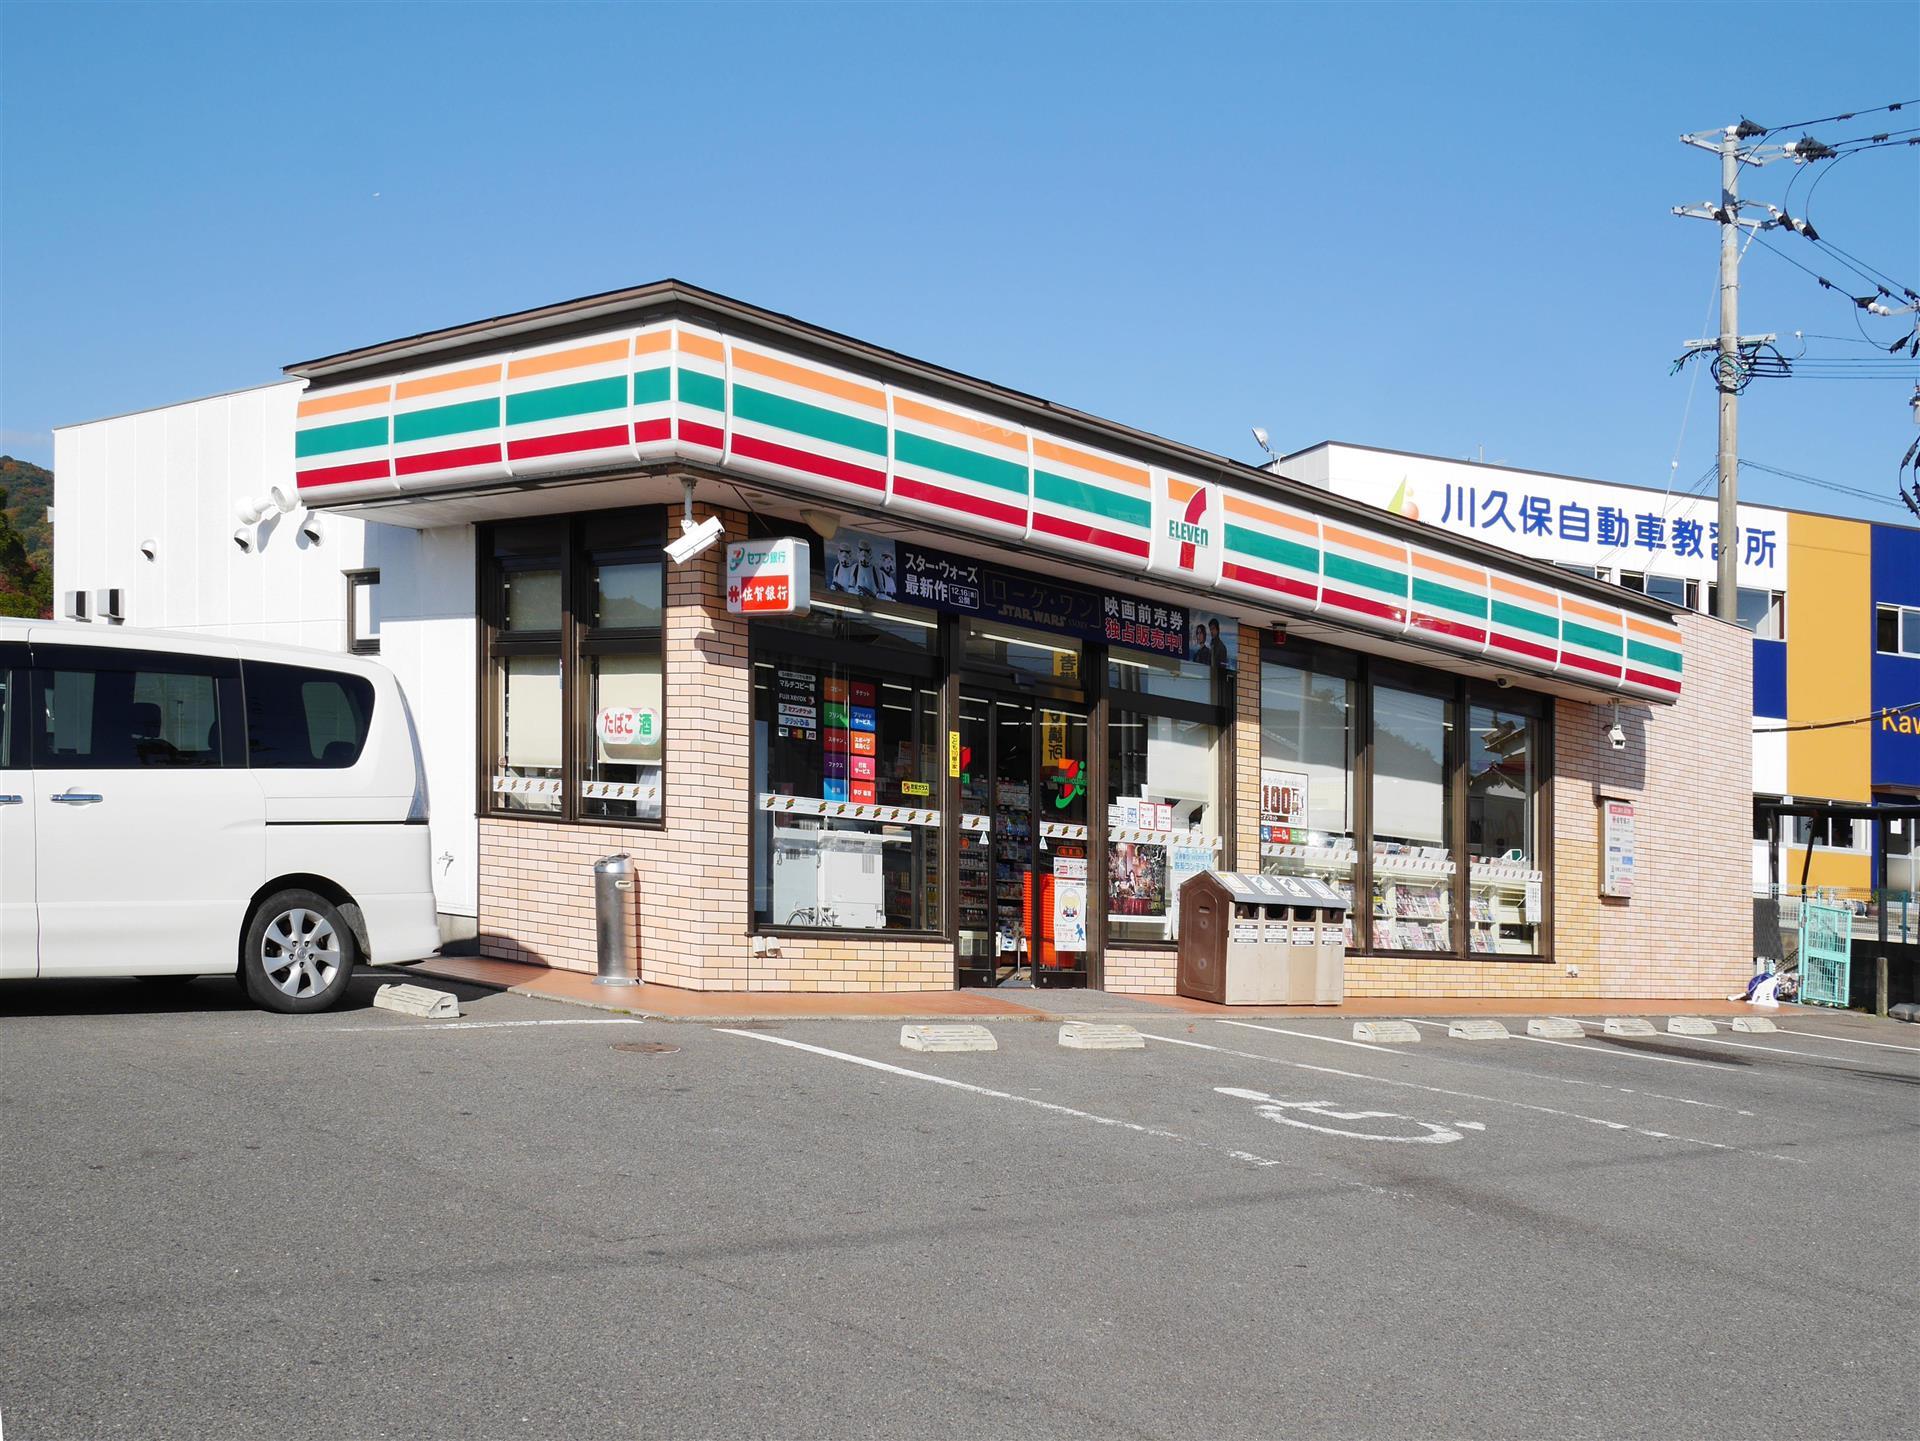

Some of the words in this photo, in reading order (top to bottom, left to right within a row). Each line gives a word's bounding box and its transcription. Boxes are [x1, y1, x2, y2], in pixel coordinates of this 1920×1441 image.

[747, 551, 786, 565] セブン銀行
[742, 585, 788, 602] 佐賀銀行
[905, 573, 948, 602] 最新作
[998, 604, 1032, 621] STAR
[1033, 610, 1067, 628] WARS
[1104, 596, 1183, 631] 映画前売券
[604, 713, 633, 734] たばこ
[639, 713, 652, 735] 酒
